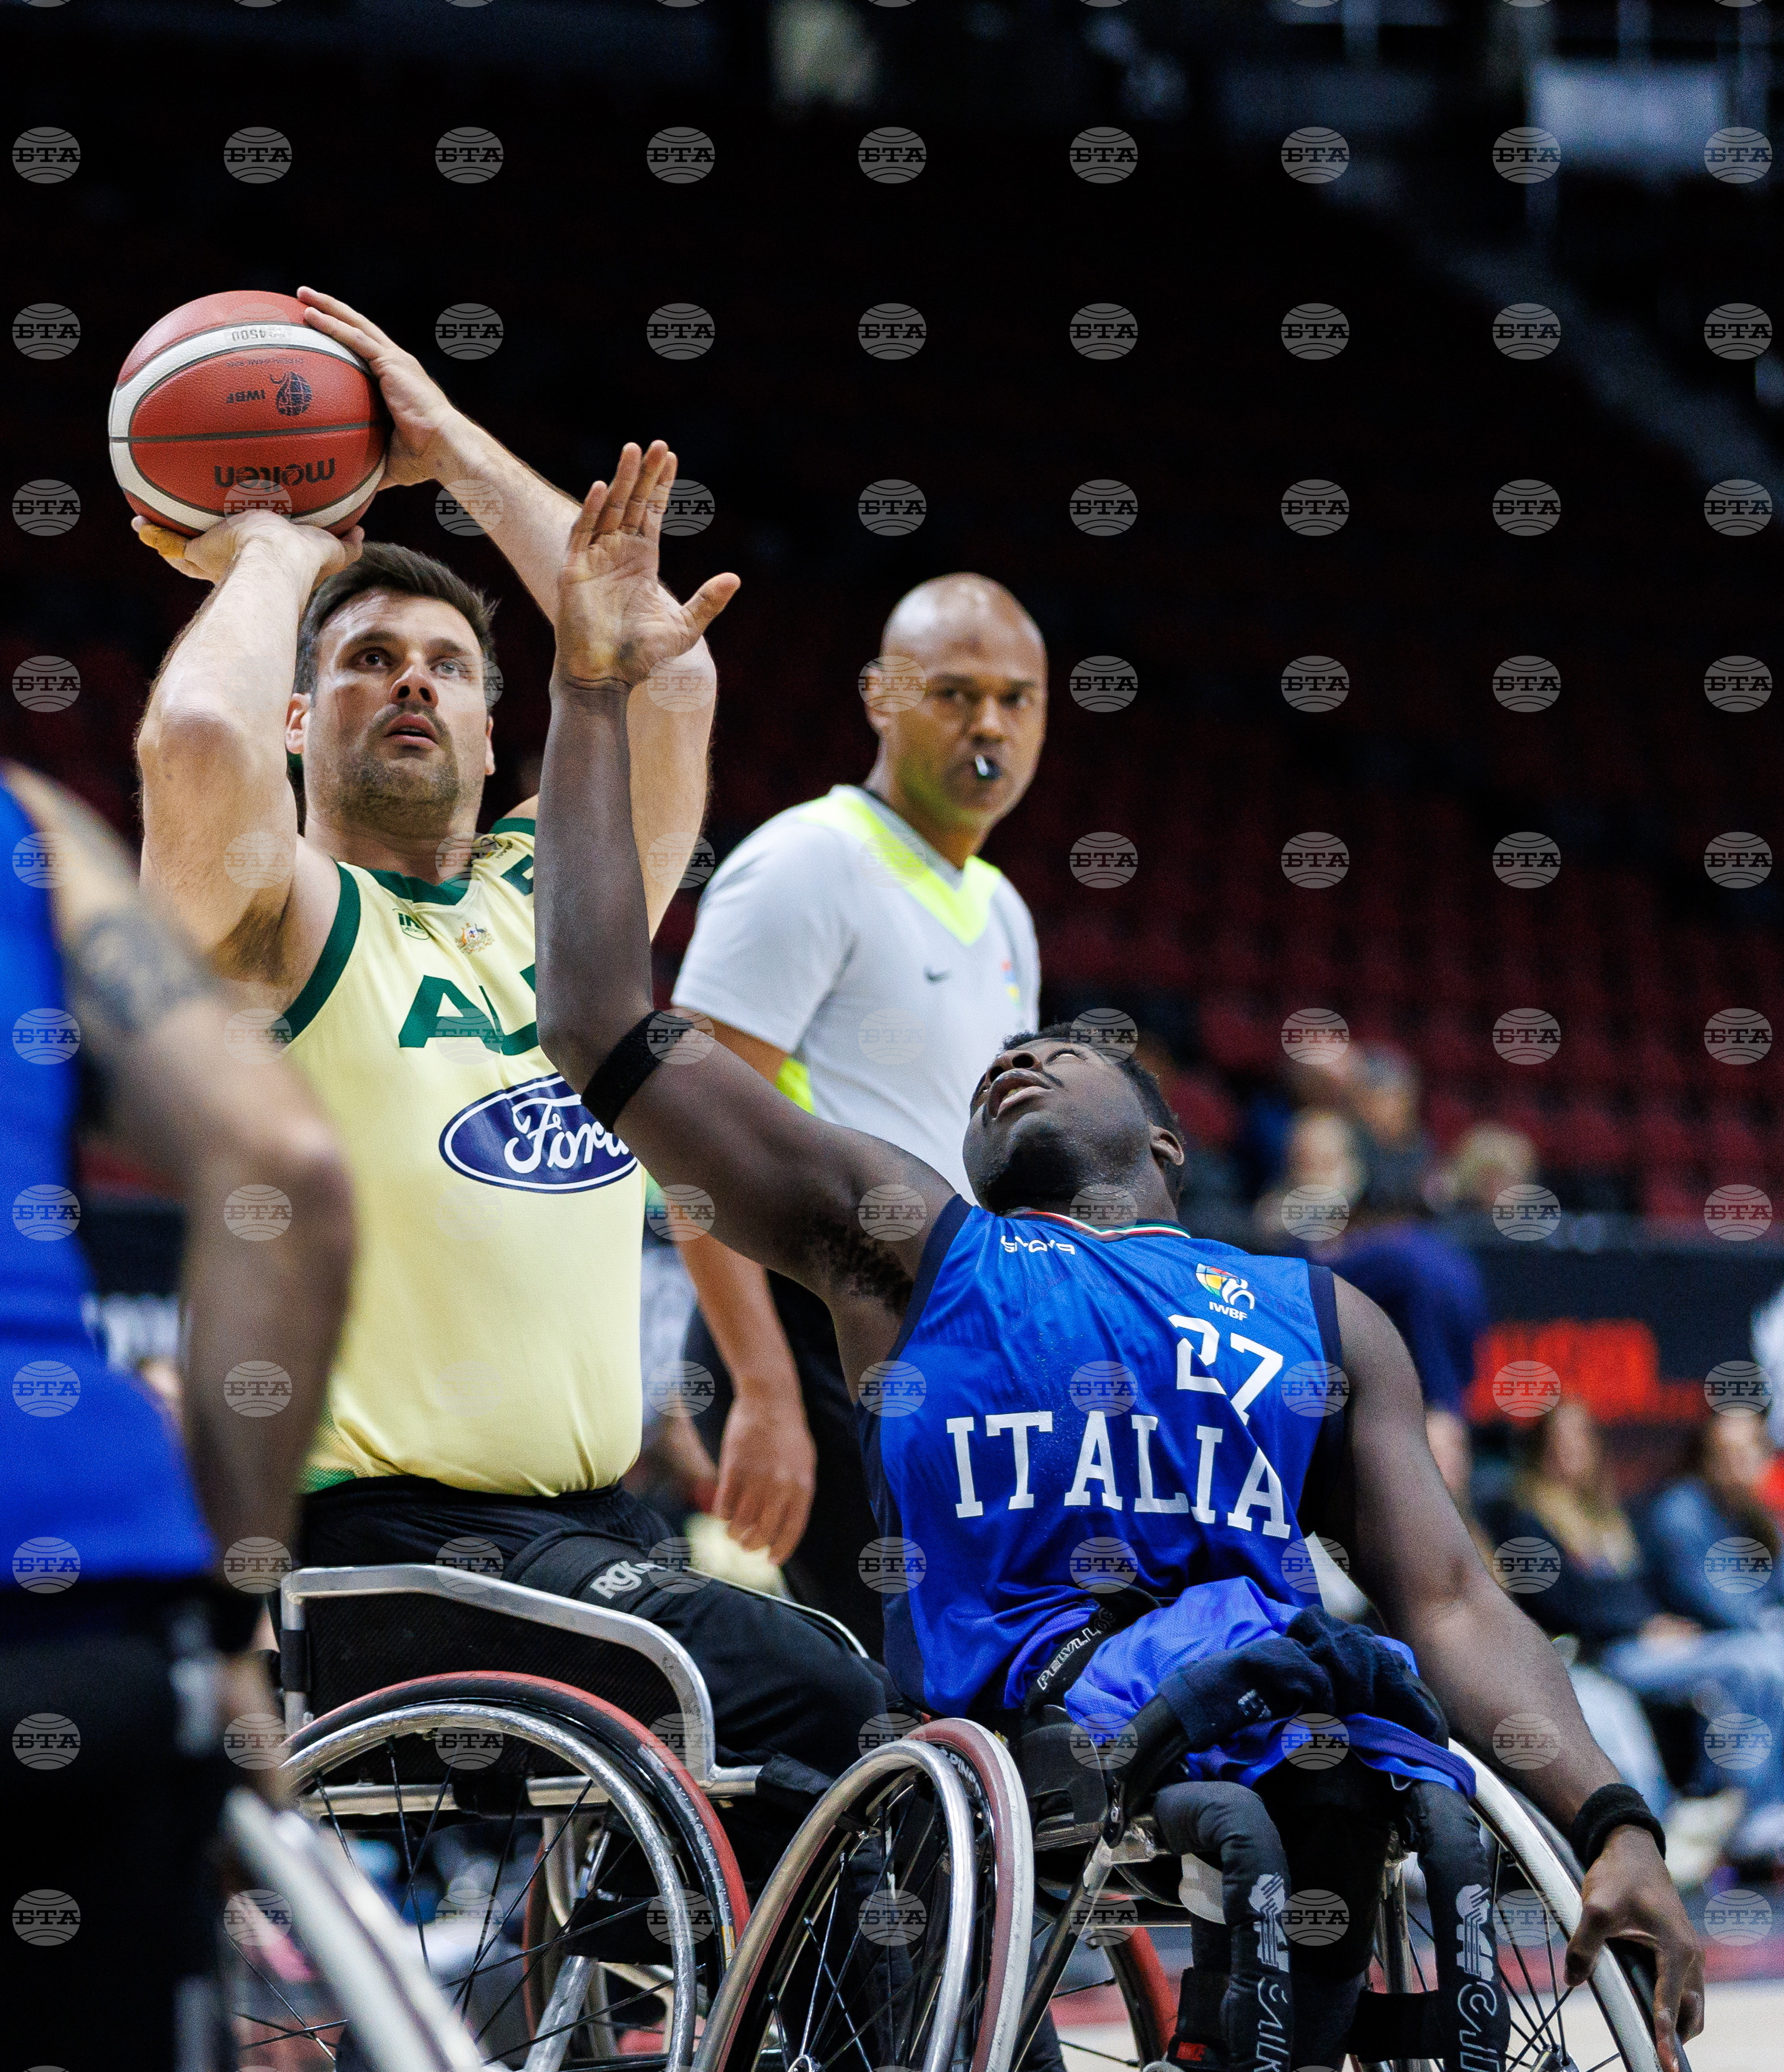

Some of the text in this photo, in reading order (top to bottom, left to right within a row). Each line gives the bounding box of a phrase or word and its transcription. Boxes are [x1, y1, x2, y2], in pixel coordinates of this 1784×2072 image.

[226, 389, 266, 404] IWBF
[214, 458, 335, 492] molten
[1209, 1301, 1248, 1321] IWBF
[1168, 1314, 1284, 1425] 27
[946, 1411, 1291, 1539] ITALIA
